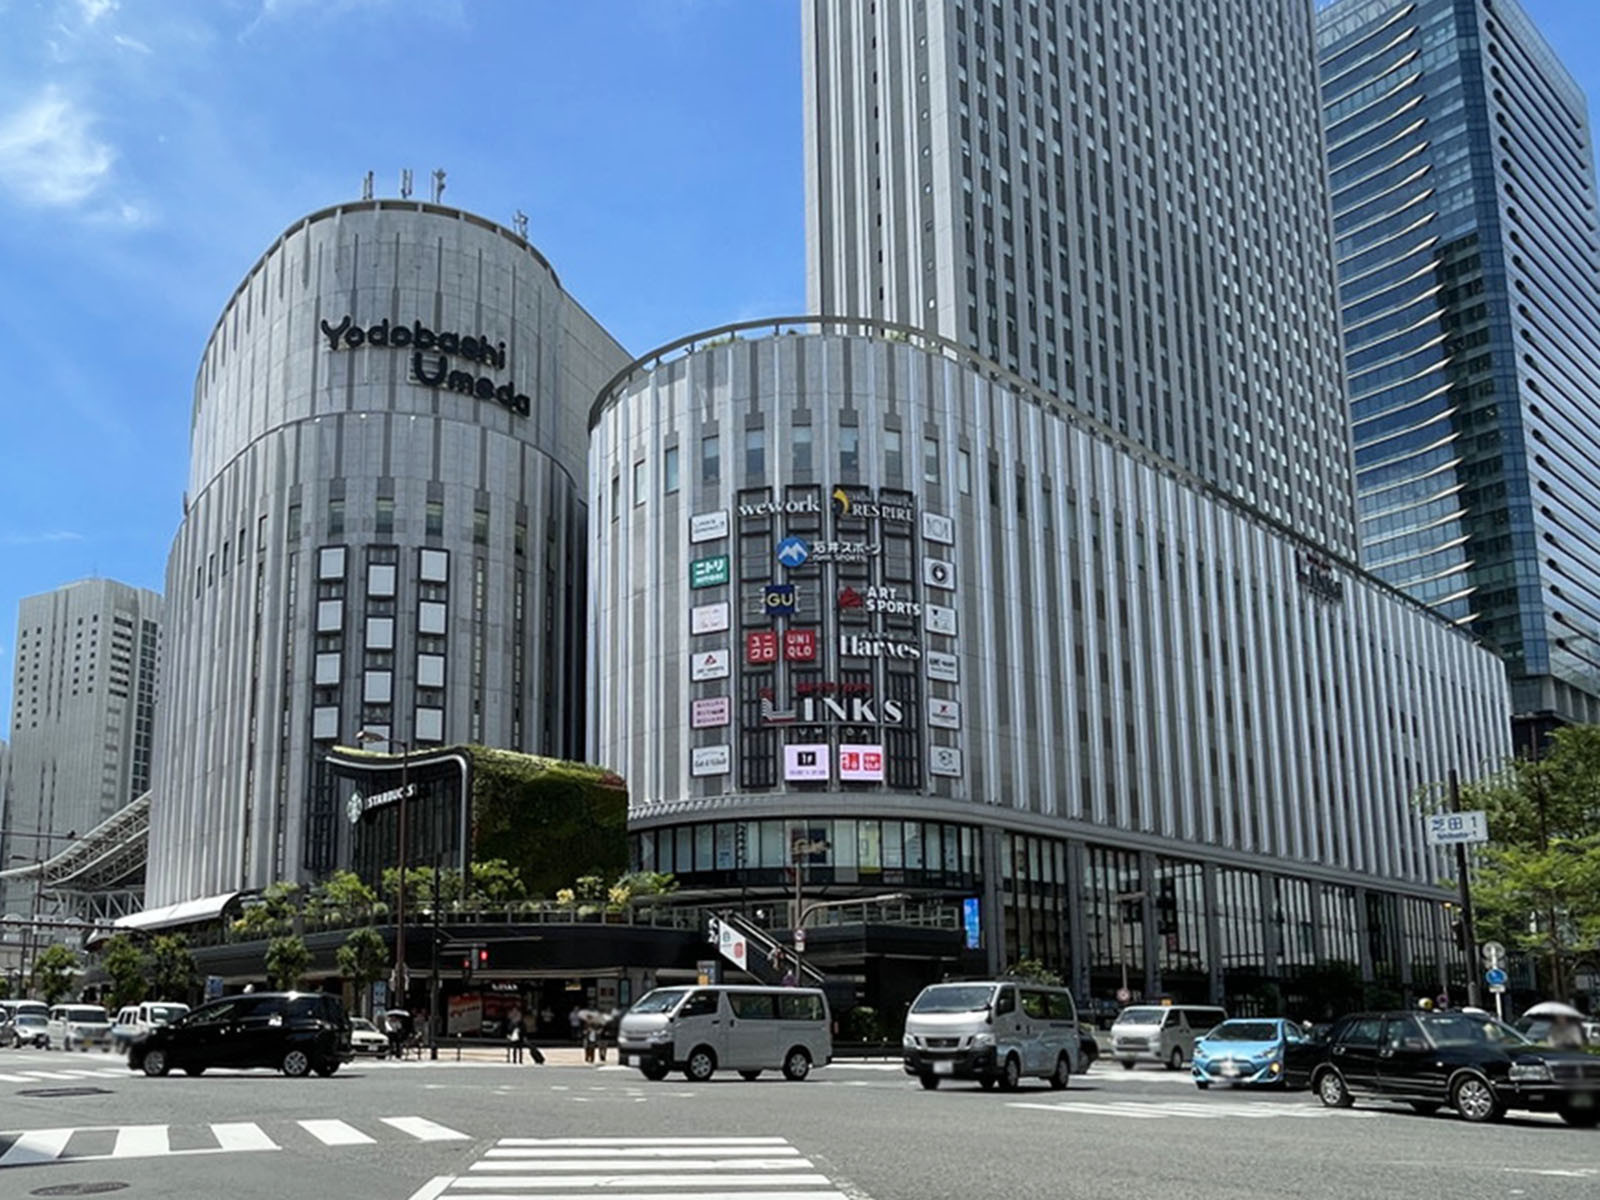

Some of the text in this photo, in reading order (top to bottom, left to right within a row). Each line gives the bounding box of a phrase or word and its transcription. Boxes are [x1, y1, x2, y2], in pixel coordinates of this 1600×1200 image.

[321, 315, 506, 370] Yodobashi
[414, 351, 531, 417] Umeda
[852, 503, 913, 521] RESPIRE
[696, 559, 724, 575] ニトリ
[766, 592, 793, 607] GU
[868, 586, 897, 599] ART
[867, 600, 921, 616] SPORTS
[786, 634, 810, 645] UNI
[840, 635, 921, 660] Harves
[786, 646, 812, 657] QLO
[761, 697, 903, 723] LINKS
[367, 784, 414, 808] STARBUCS
[1471, 815, 1477, 828] 1
